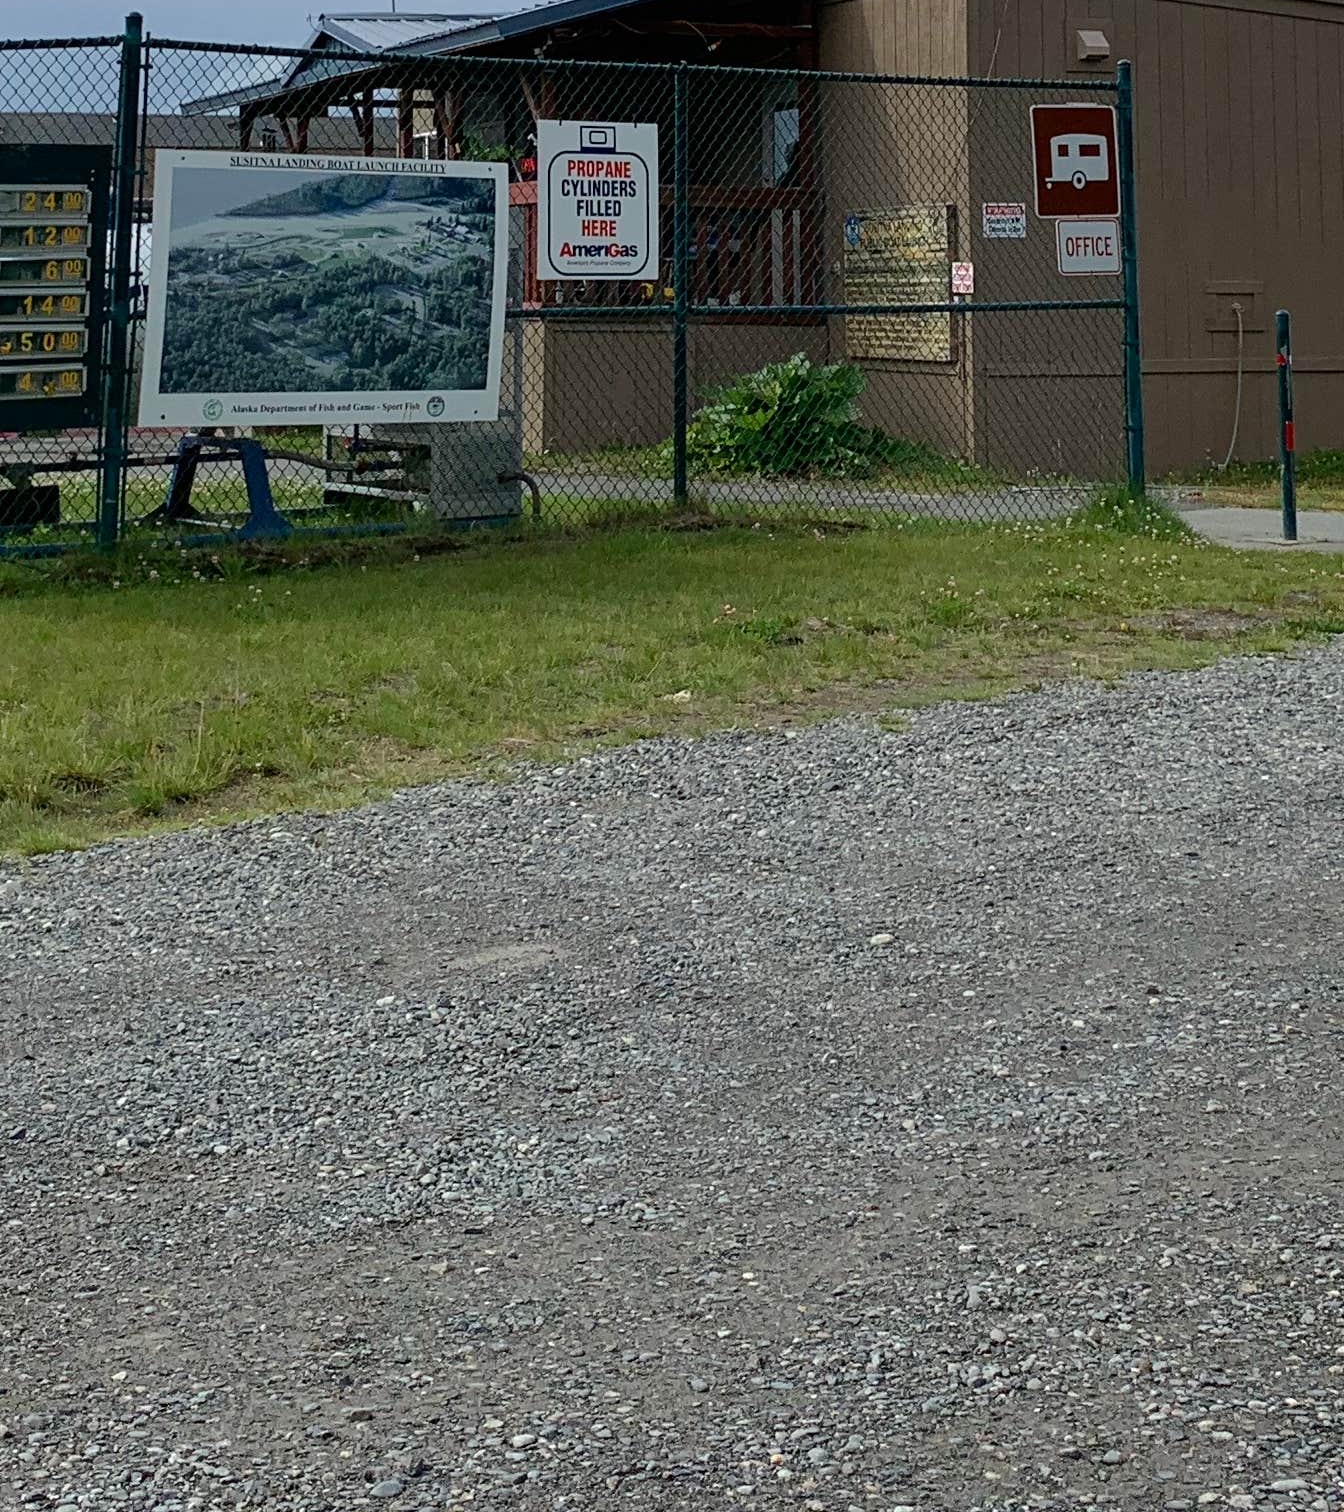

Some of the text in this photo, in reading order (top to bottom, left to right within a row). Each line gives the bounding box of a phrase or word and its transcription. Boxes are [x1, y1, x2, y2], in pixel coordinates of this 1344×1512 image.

[230, 156, 446, 175] SUSITNA LANDING BOAT LAUNCH FACILITY
[567, 159, 631, 178] PROPANE
[561, 179, 637, 198] CYLINDERS
[576, 199, 621, 217] FILLED
[581, 219, 617, 237] HERE
[560, 242, 638, 258] AmeriGas
[1066, 236, 1113, 258] OFFICE
[231, 405, 257, 413] Alaska
[260, 403, 306, 414] Department
[308, 403, 317, 412] of
[319, 402, 335, 412] Fish
[337, 402, 351, 411] and
[353, 403, 375, 411] Game
[382, 402, 403, 413] Sport
[405, 401, 420, 411] Fish
